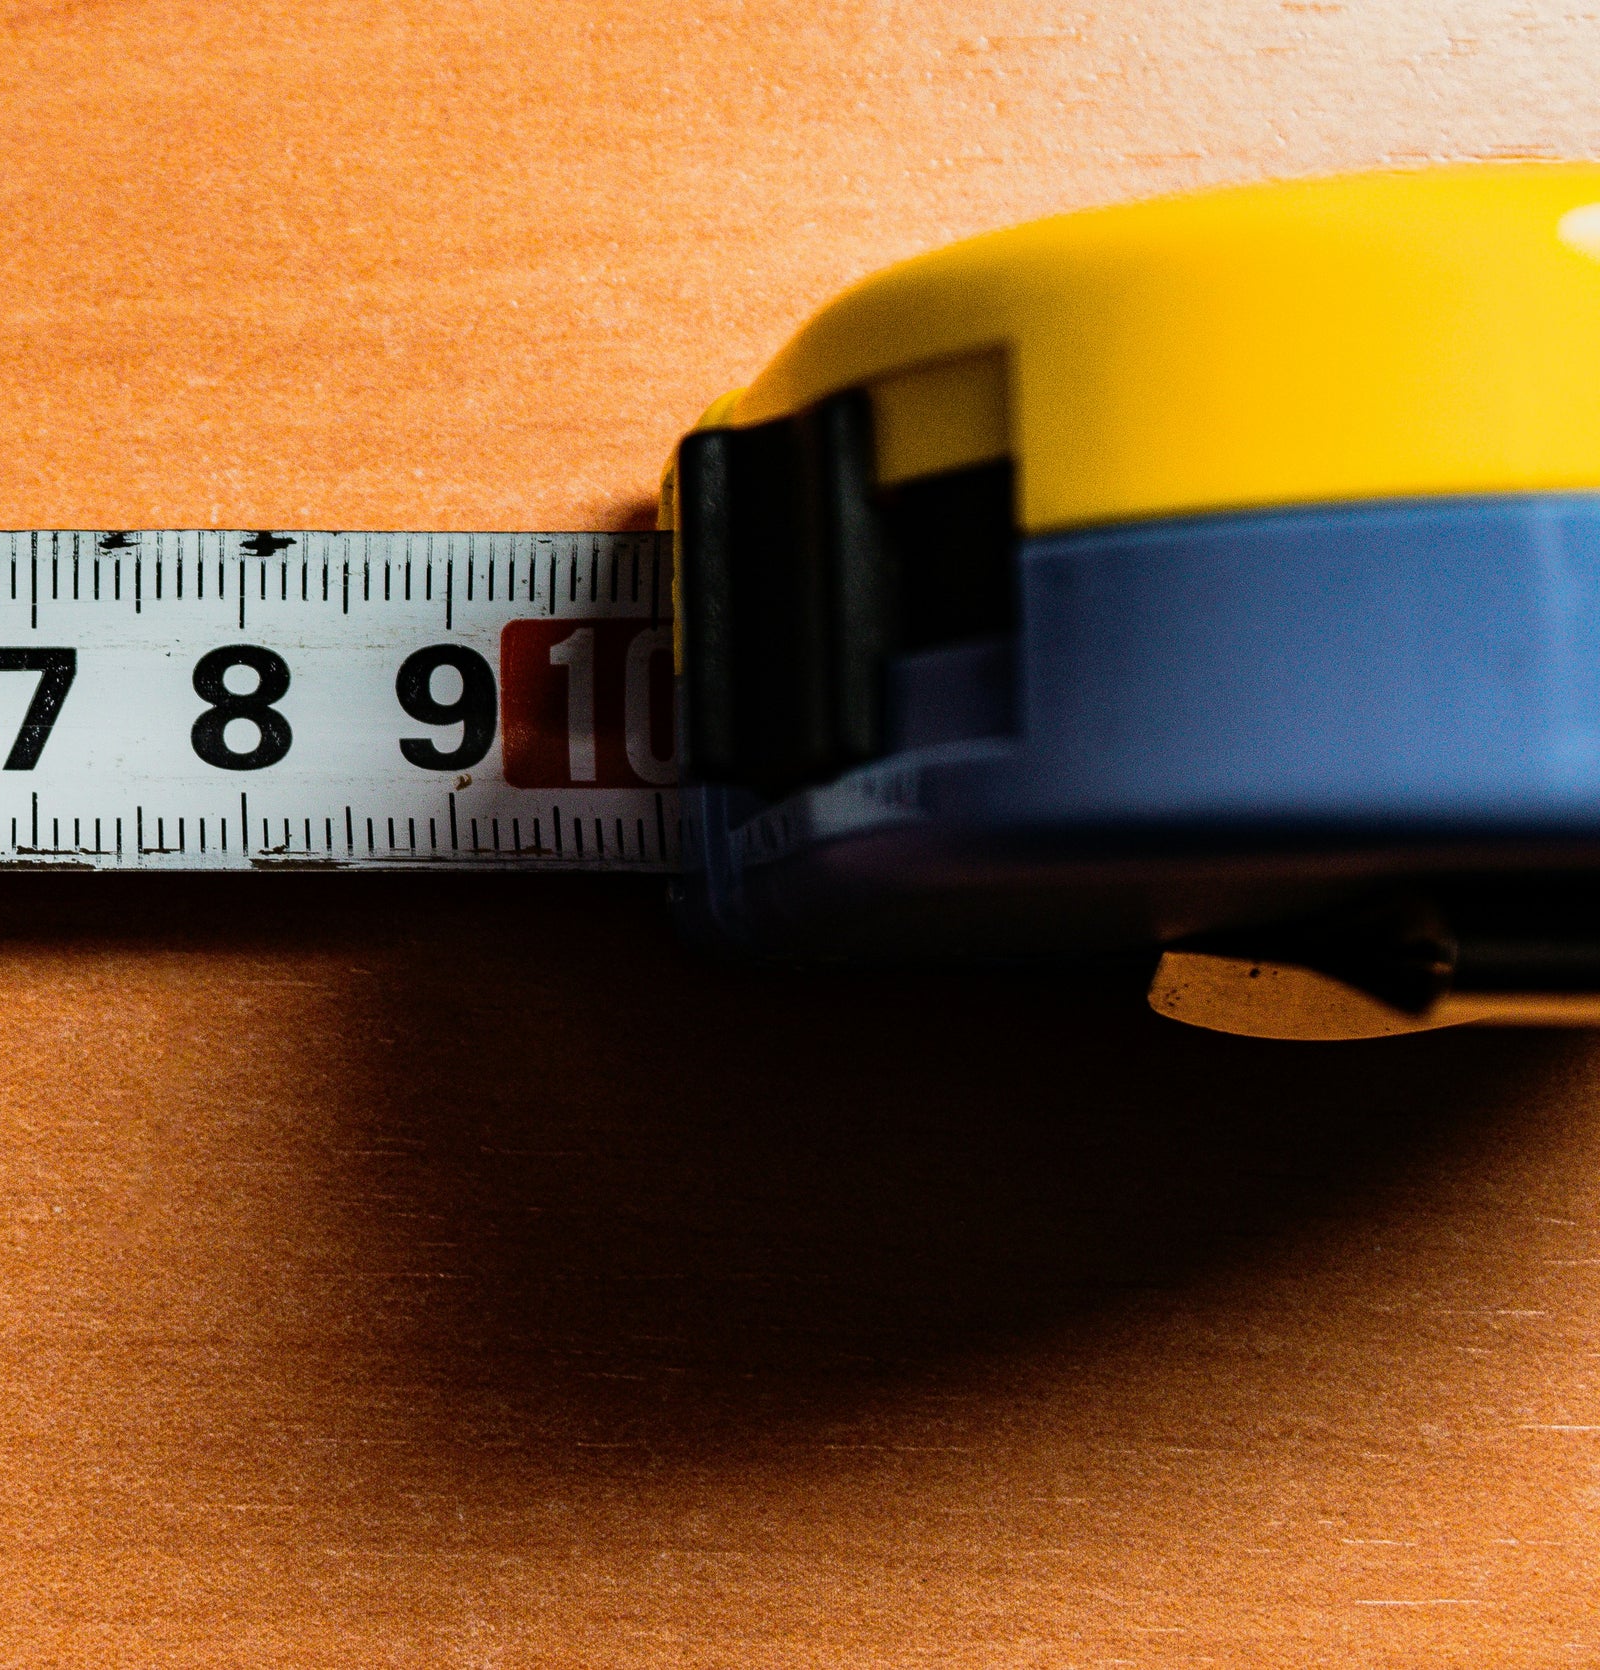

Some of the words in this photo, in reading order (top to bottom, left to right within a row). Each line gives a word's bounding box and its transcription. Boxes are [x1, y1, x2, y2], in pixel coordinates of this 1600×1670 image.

[190, 643, 293, 771] 8
[394, 642, 498, 772] 9
[548, 626, 680, 786] 10
